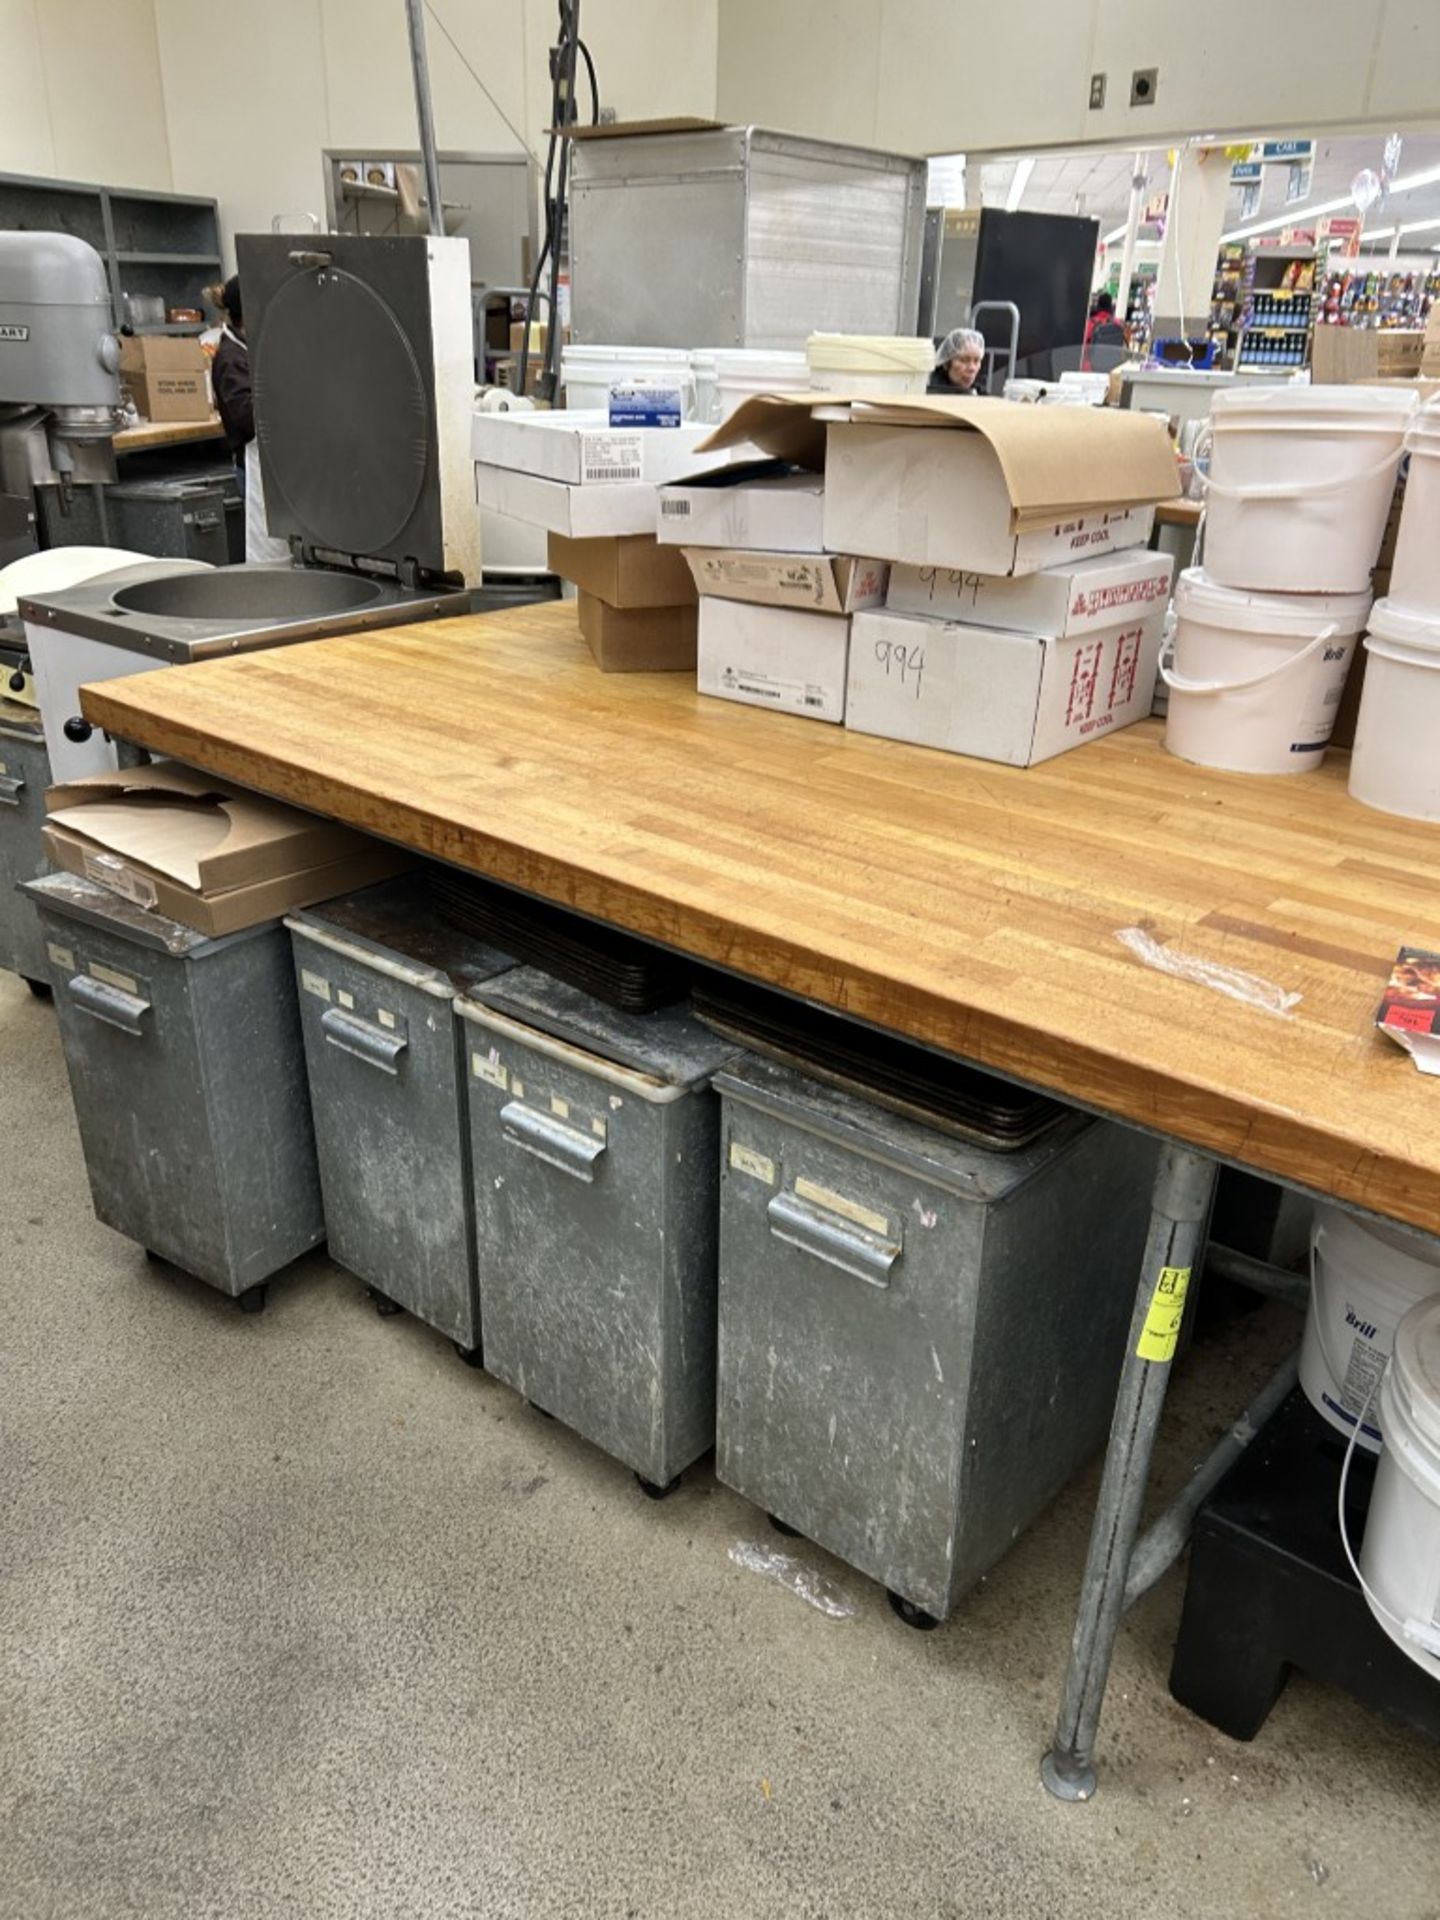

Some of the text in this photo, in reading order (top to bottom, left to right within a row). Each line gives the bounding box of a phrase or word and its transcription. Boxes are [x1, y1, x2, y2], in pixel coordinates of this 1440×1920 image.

[1070, 529, 1110, 549] KEEP COOL
[874, 640, 925, 700] 994
[1344, 1310, 1377, 1340] Brill
